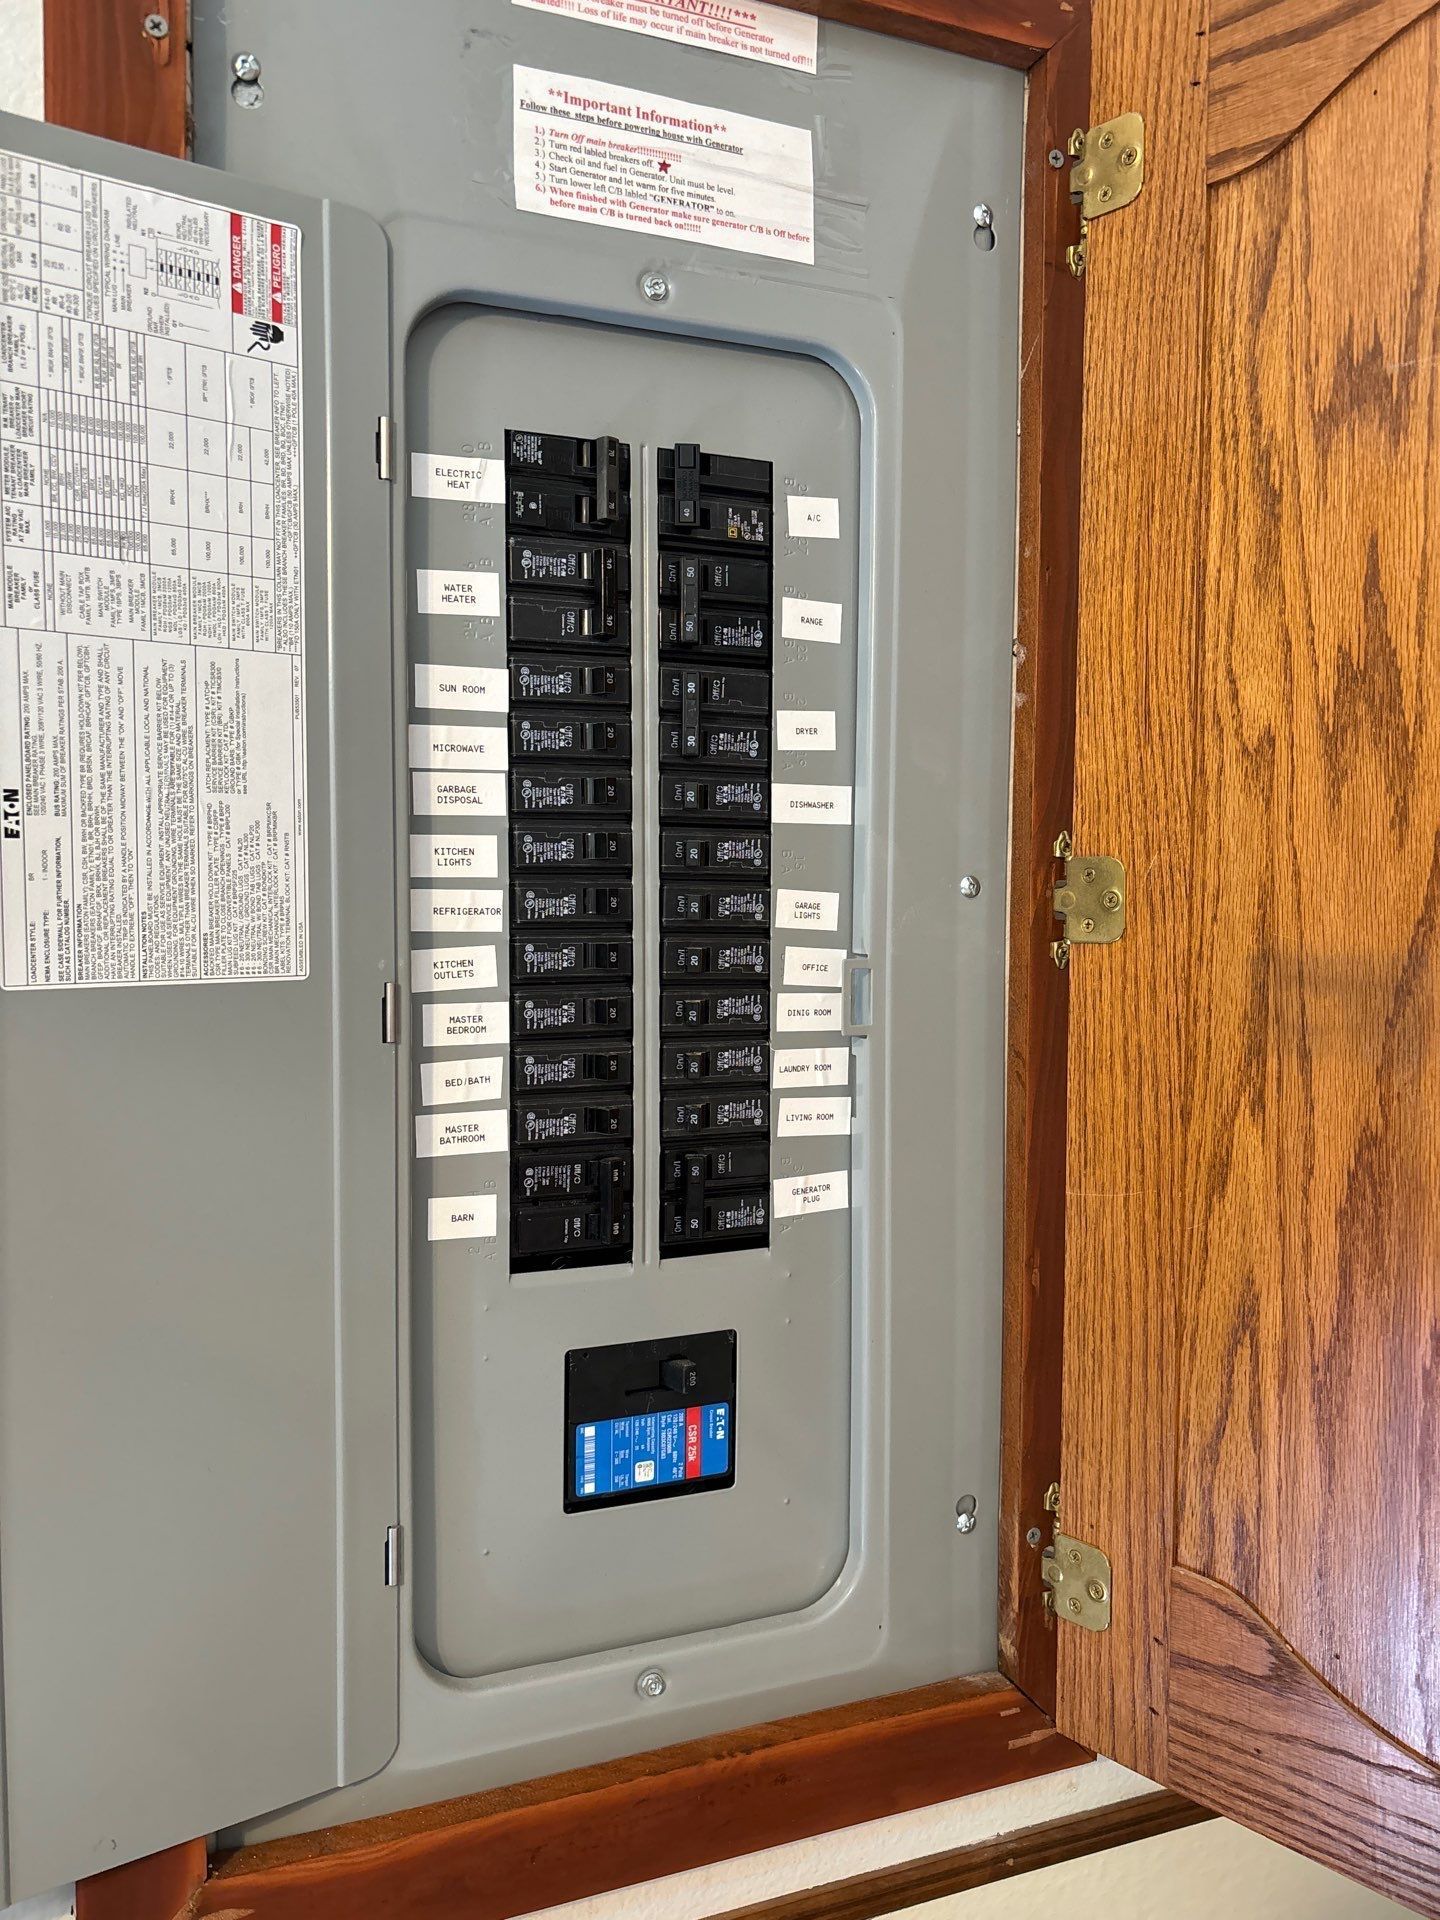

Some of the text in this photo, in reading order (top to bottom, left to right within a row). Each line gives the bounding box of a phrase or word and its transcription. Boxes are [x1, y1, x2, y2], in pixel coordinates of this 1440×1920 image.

[626, 3, 648, 14] must
[650, 6, 660, 17] be
[662, 10, 689, 23] turned
[691, 17, 705, 27] off
[706, 20, 732, 34] before
[734, 27, 774, 44] Generator
[577, 3, 598, 16] Loss
[600, 9, 611, 18] of
[612, 11, 627, 22] life
[629, 16, 648, 28] may
[650, 20, 674, 32] occur
[676, 25, 686, 35] if
[685, 29, 706, 41] main
[708, 33, 739, 48] breaker
[741, 41, 748, 50] is
[749, 45, 763, 55] not
[765, 48, 790, 61] turned
[519, 99, 744, 154] Follow these steps before powering house with Generator
[535, 126, 546, 136] 1.)
[549, 128, 569, 140] Turn
[571, 133, 585, 144] Off
[586, 137, 606, 148] main
[534, 137, 546, 147] 2.)
[548, 139, 568, 151] Turn
[569, 145, 582, 154] red
[584, 146, 607, 159] labled
[608, 152, 640, 165] breakers
[534, 149, 736, 196] 3.) Check oil and fuel in Generator. Unit must be level.
[534, 160, 716, 203] 4.) Start Generator and let warm for five minutes.
[534, 172, 546, 183] 5.)
[549, 173, 568, 186] Turn
[570, 178, 591, 190] lower
[593, 182, 606, 193] left
[608, 185, 623, 196] C/B
[624, 188, 648, 201] labled
[716, 206, 724, 215] to
[535, 183, 810, 242] 6.) When finished with Generator make sure generator C/B is Off before
[549, 197, 576, 210] before
[577, 203, 598, 213] main
[599, 206, 616, 218] C/B
[617, 210, 624, 219] is
[625, 211, 652, 224] turned
[654, 216, 677, 230] back
[232, 234, 241, 279] DANGER
[272, 243, 281, 289] PELIGRO
[435, 467, 482, 480] ELECTRIC
[447, 480, 470, 490] HEAT
[807, 514, 821, 522] A/C
[686, 566, 695, 578] 50
[443, 583, 473, 593] WATER
[441, 594, 476, 604] HEATER
[606, 614, 613, 626] 30
[800, 616, 823, 626] RANGE
[686, 620, 694, 632] 50
[606, 672, 614, 684] 20
[438, 683, 486, 694] SUN ROOM
[687, 682, 696, 694] 30
[795, 727, 818, 735] DRYER
[687, 735, 696, 747] 30
[432, 743, 485, 753] MICROWAVE
[436, 785, 477, 794] GARBAGE
[607, 785, 615, 797] 20
[25, 782, 33, 816] ENCLOSED
[436, 796, 483, 805] DISPOSAL
[686, 791, 695, 802] 20
[789, 800, 834, 810] DISHWASHER
[434, 848, 475, 856] KITCHEN
[437, 858, 472, 867] LIGHTS
[610, 896, 617, 908] 20
[794, 901, 821, 910] GARAGE
[432, 907, 502, 916] REFRIGERATOR
[690, 902, 698, 914] 20
[794, 911, 821, 920] LIGHTS
[202, 932, 210, 976] ACCESSORIES
[29, 943, 37, 983] LOADCENTER
[433, 959, 474, 969] KITCHEN
[802, 963, 829, 972] OFFICE
[433, 969, 474, 980] OUTLETS
[609, 1007, 617, 1019] 20
[688, 1010, 697, 1022] 20
[787, 1008, 832, 1017] DINIG ROOM
[449, 1015, 484, 1024] MASTER
[446, 1025, 487, 1034] BEDROOM
[779, 1063, 832, 1074] LAUNDRY ROOM
[445, 1075, 491, 1088] BED/BATH
[690, 1113, 698, 1125] 20
[786, 1113, 834, 1122] LIVING ROOM
[445, 1124, 480, 1134] MASTER
[610, 1118, 617, 1129] 20
[439, 1134, 485, 1145] BATHROOM
[691, 1166, 700, 1177] 50
[791, 1183, 831, 1195] GENERATOR
[802, 1195, 820, 1204] PLUG
[451, 1213, 474, 1223] BARN
[690, 1218, 699, 1229] 50
[689, 1371, 697, 1386] 200
[687, 1424, 697, 1462] CSR 25k
